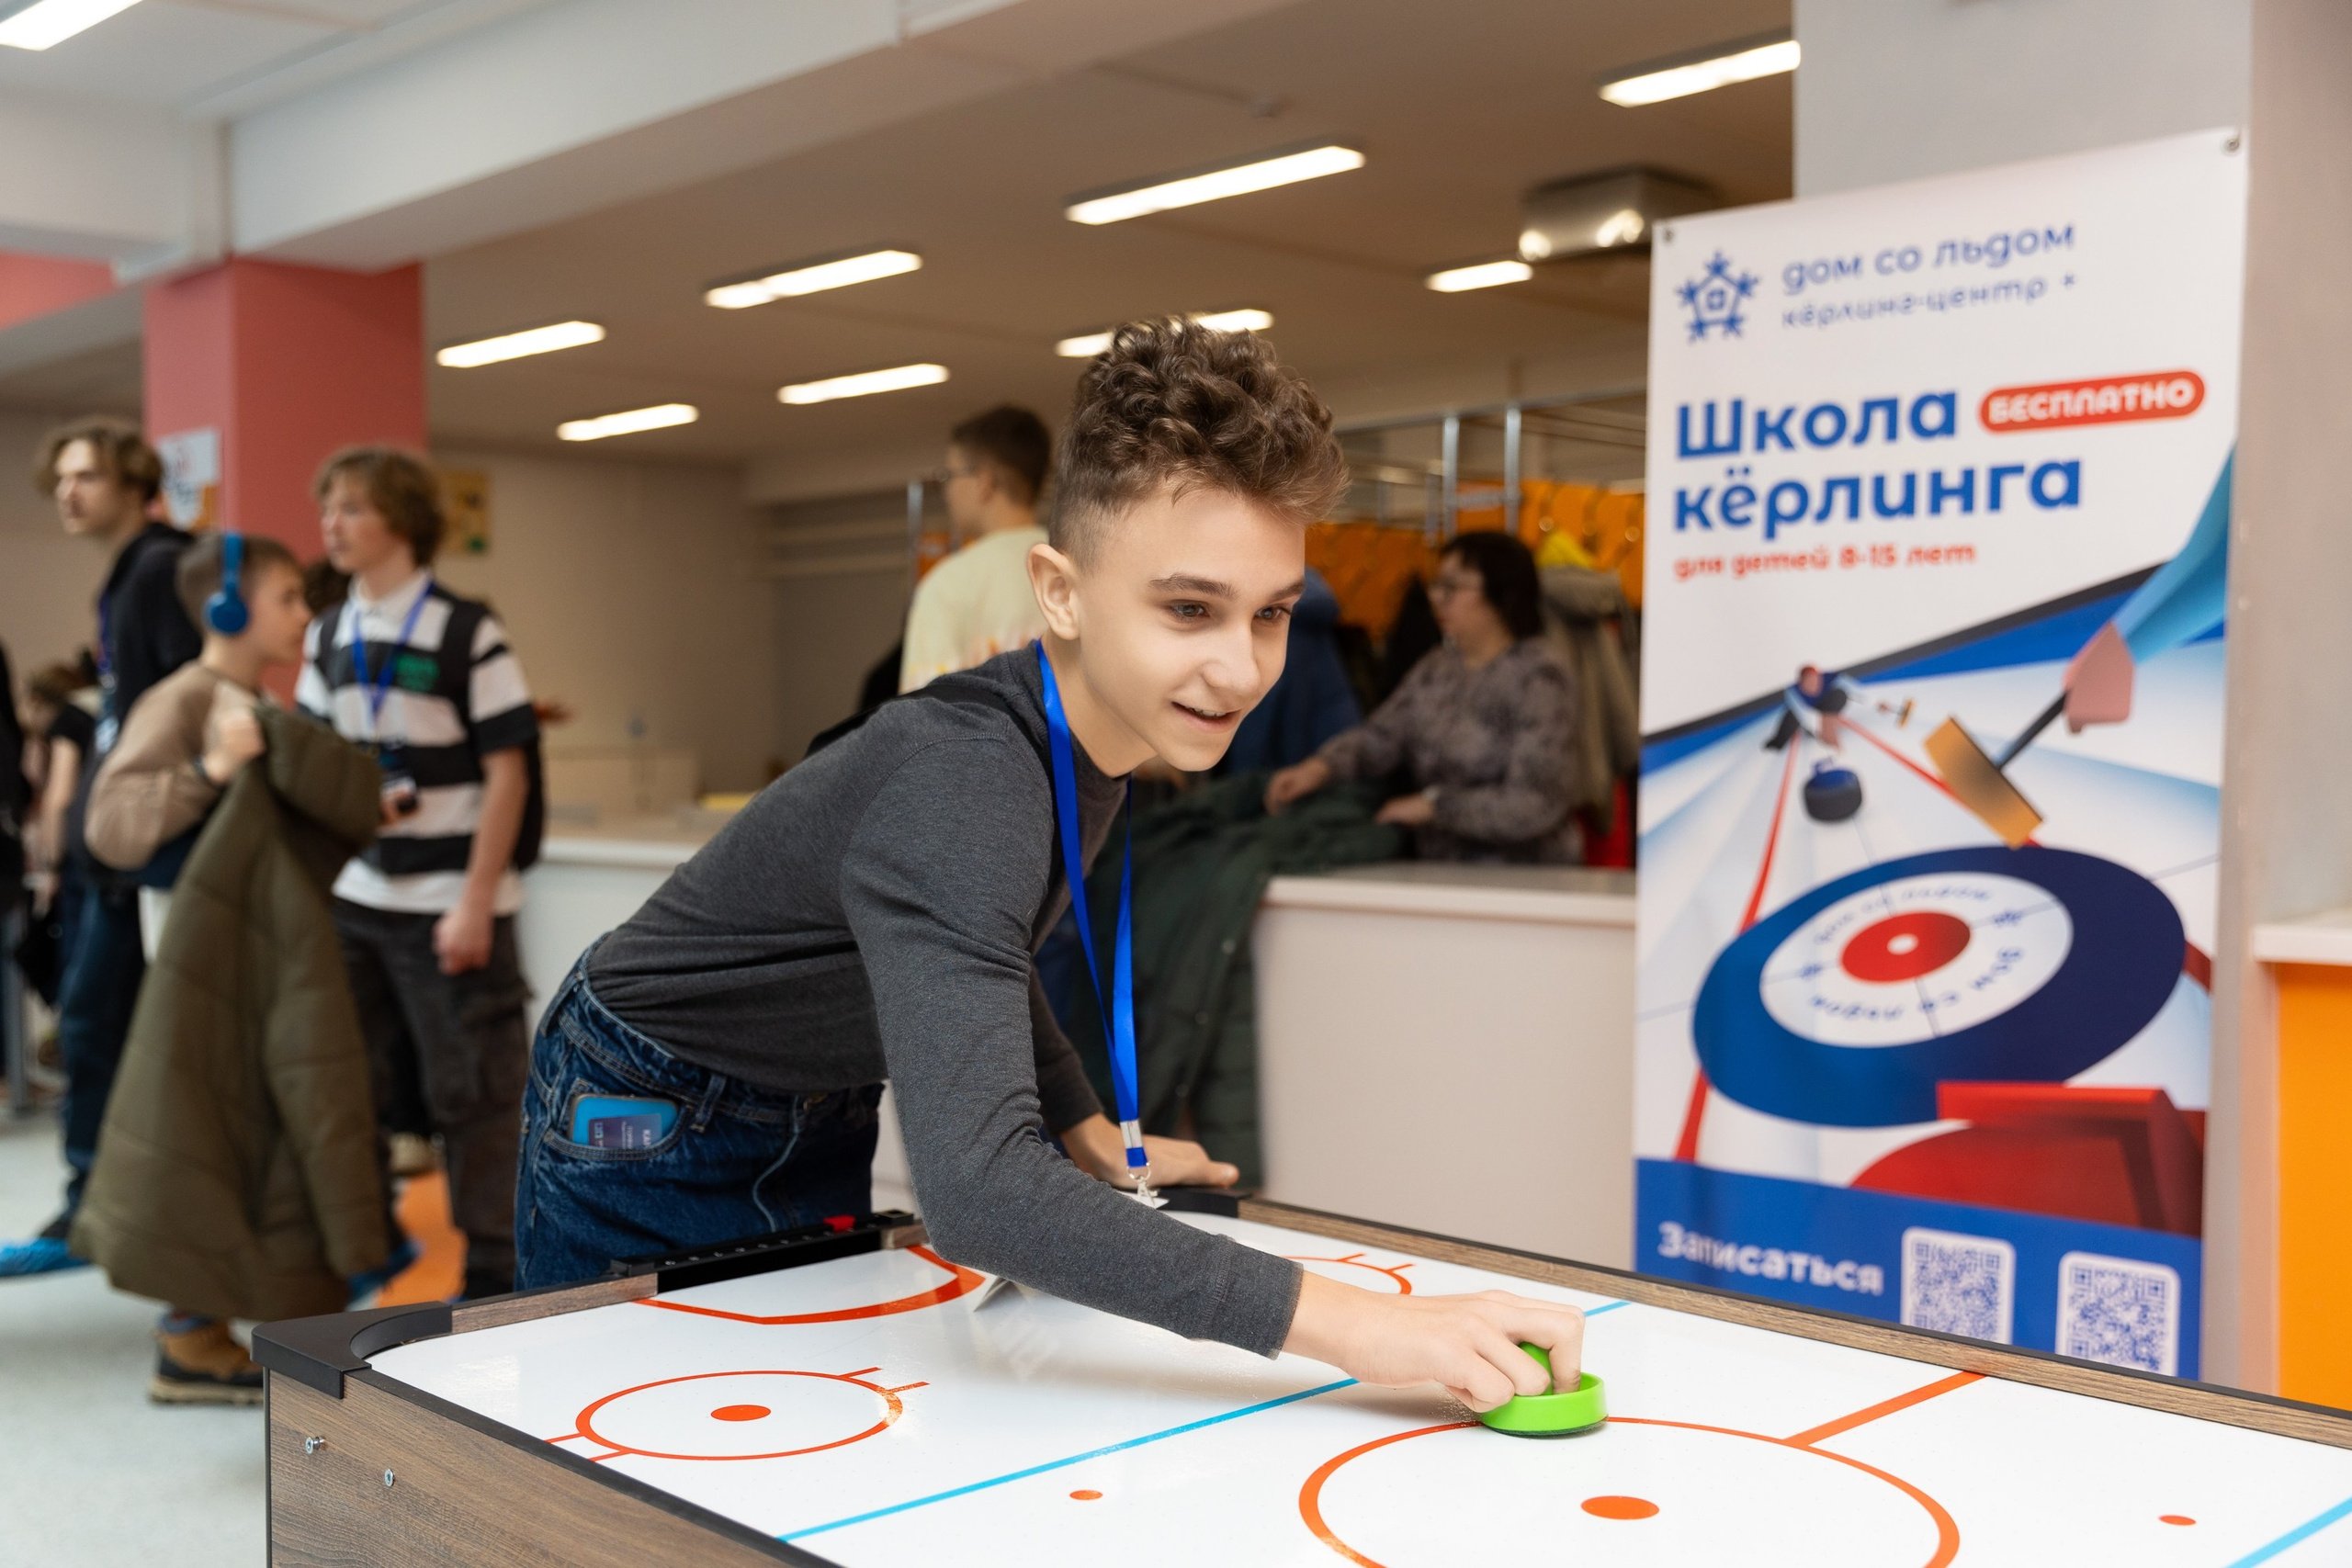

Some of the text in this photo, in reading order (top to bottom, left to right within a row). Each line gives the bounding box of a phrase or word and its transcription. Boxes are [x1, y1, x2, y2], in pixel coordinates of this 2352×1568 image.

[1783, 225, 2075, 292] дом со льдом
[1678, 391, 1958, 458] Школа
[1988, 380, 2194, 425] БЕСПЛАТНО
[1675, 459, 2081, 541] кёрлинга
[1674, 543, 1977, 582] для детей 8-15 лет
[1658, 1222, 1883, 1295] Записаться
